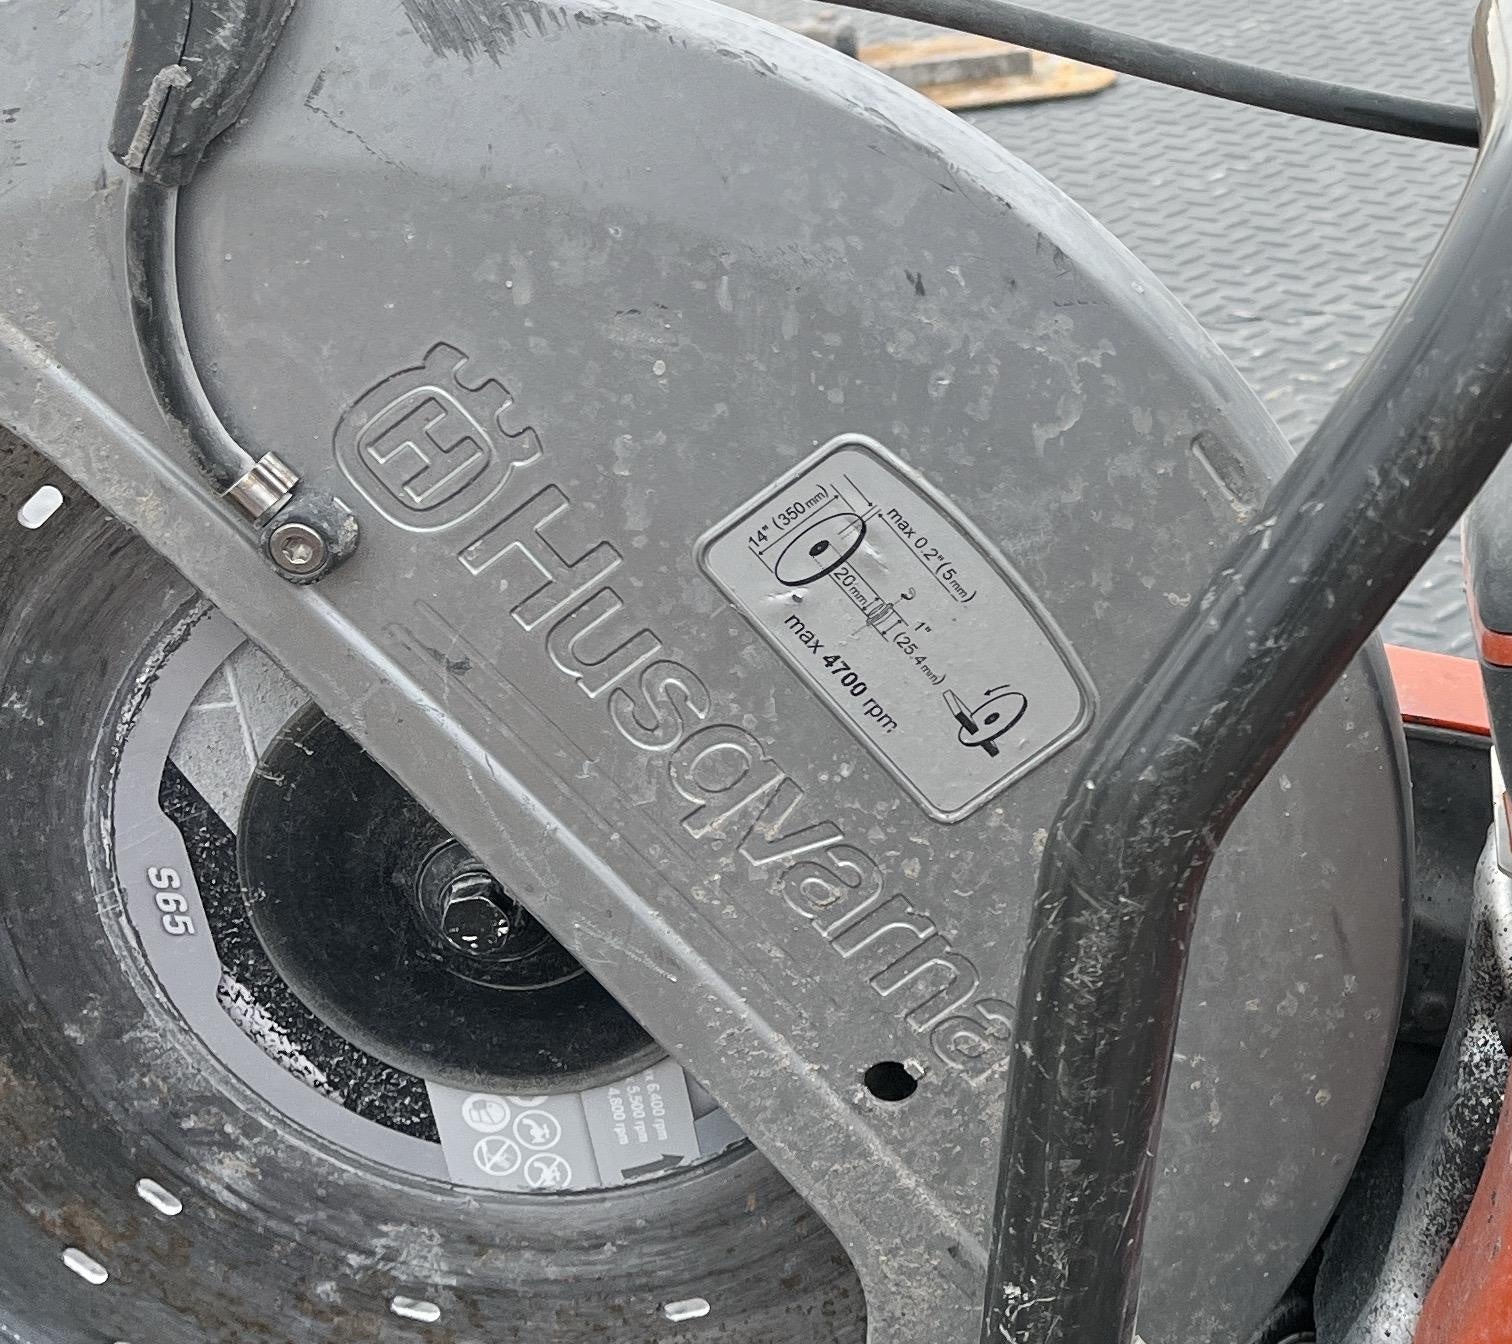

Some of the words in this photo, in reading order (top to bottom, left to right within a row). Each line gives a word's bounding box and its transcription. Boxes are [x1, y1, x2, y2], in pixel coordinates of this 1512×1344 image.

[886, 508, 917, 539] max
[784, 613, 825, 656] max
[823, 652, 869, 698] 4700
[862, 695, 899, 734] rpm
[457, 482, 1017, 1088] Husqvarna
[147, 866, 196, 936] S65
